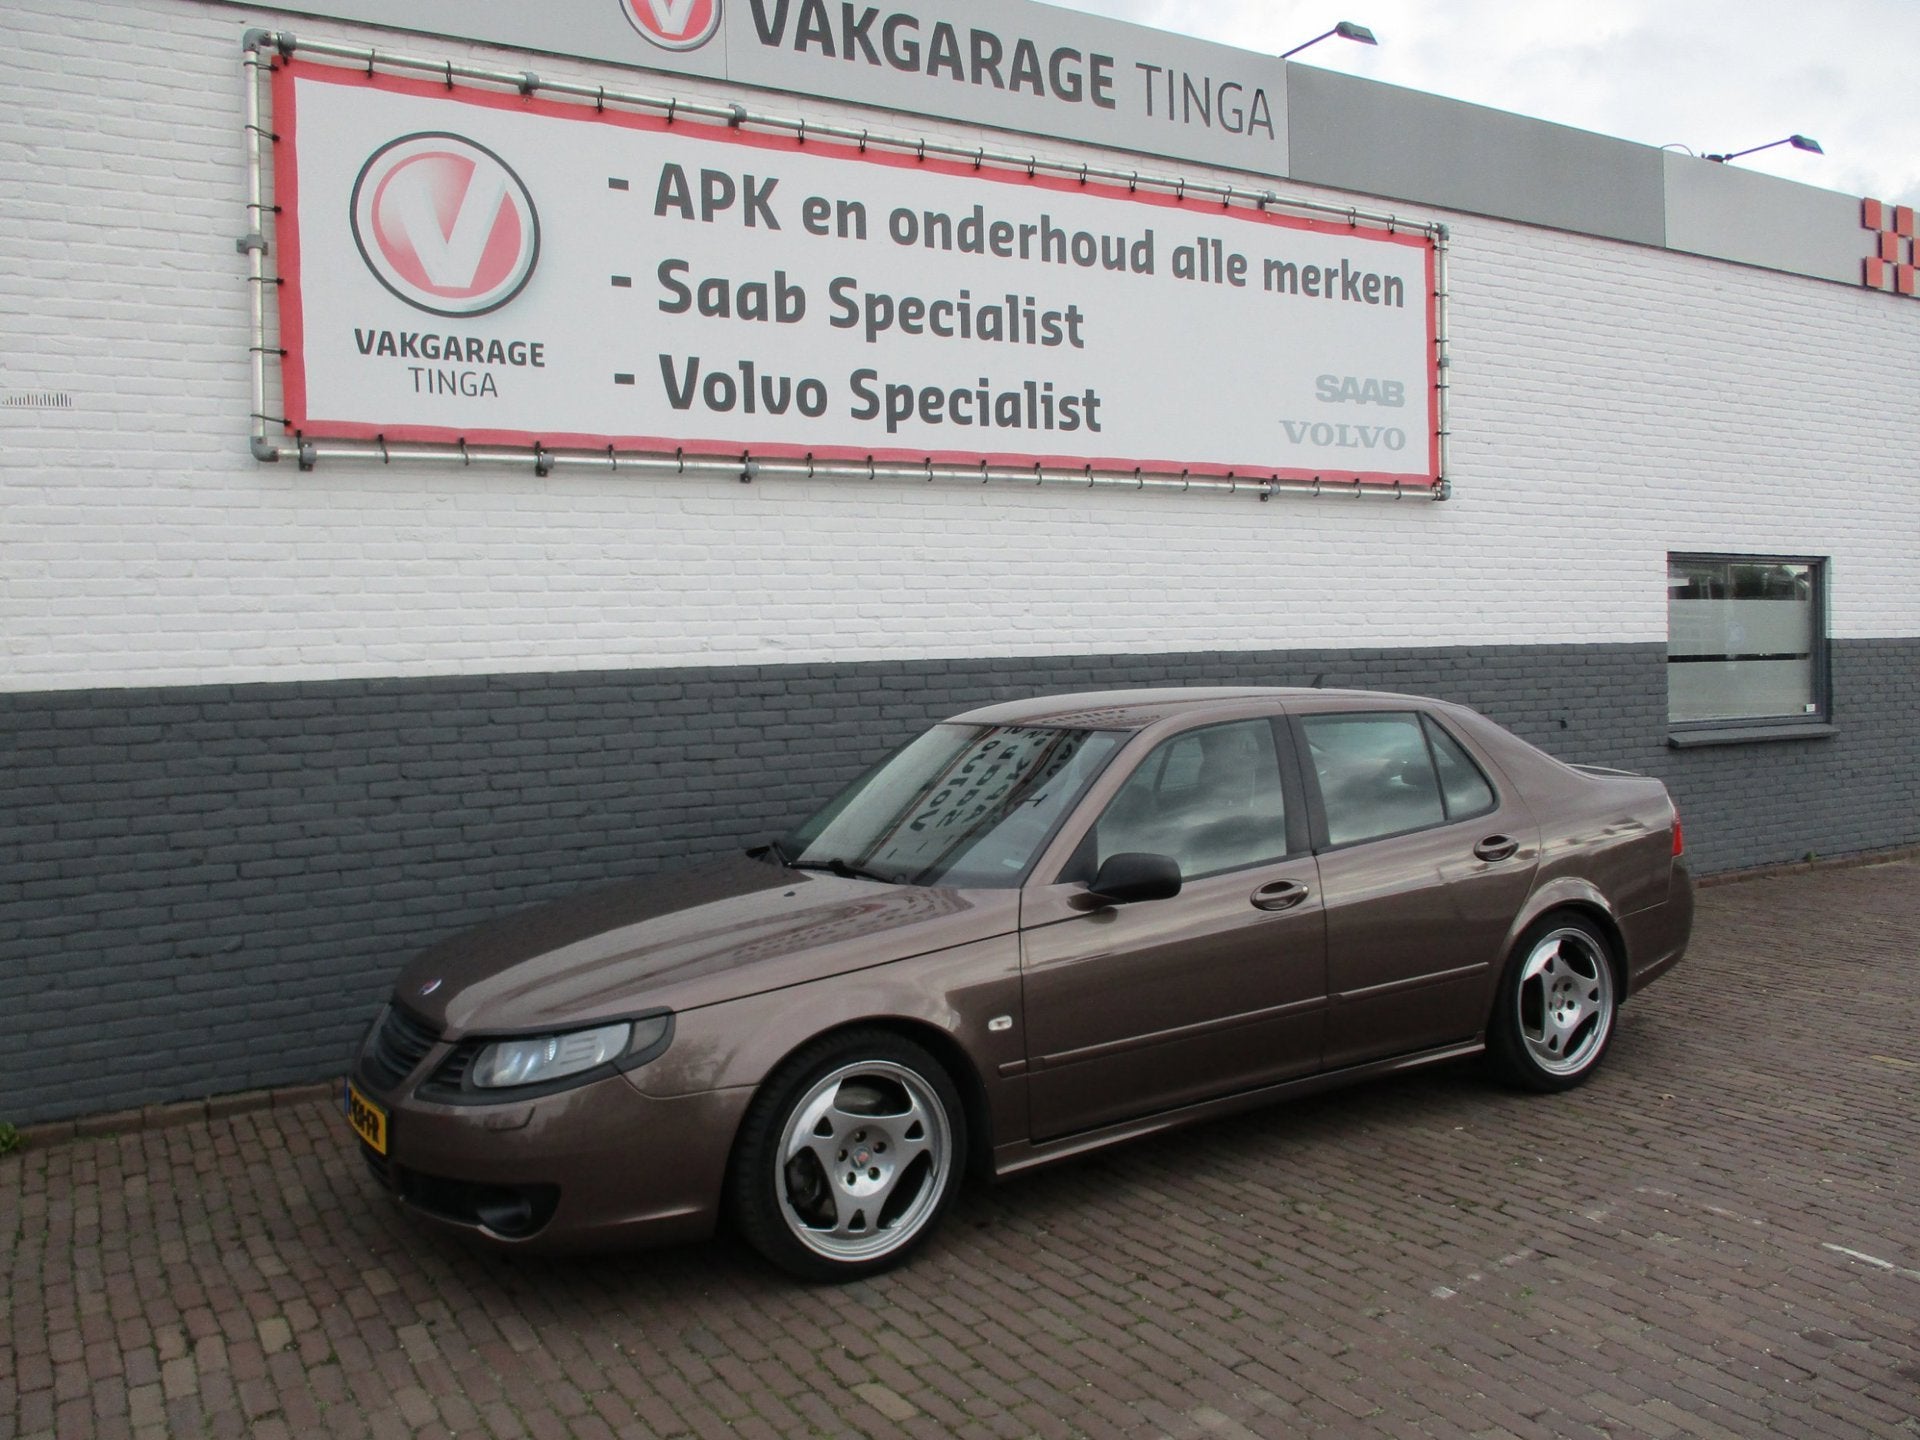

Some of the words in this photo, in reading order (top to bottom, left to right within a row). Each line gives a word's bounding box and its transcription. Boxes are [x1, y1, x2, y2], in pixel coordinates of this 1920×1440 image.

[749, 0, 1116, 109] VAKGARAGE
[1135, 62, 1275, 140] TINGA
[654, 163, 781, 230] APK
[802, 196, 867, 240] en
[889, 204, 1154, 275] onderhoud
[1172, 237, 1247, 287] alle
[1263, 259, 1403, 308] merken
[657, 258, 806, 324] Saab
[828, 276, 1084, 349] Specialist
[354, 328, 545, 368] VAKGARAGE
[407, 366, 498, 398] TINGA
[658, 354, 828, 418] Volvo
[850, 368, 1101, 434] Specialist
[1315, 374, 1406, 408] SAAB
[1278, 420, 1406, 451] VOLVO
